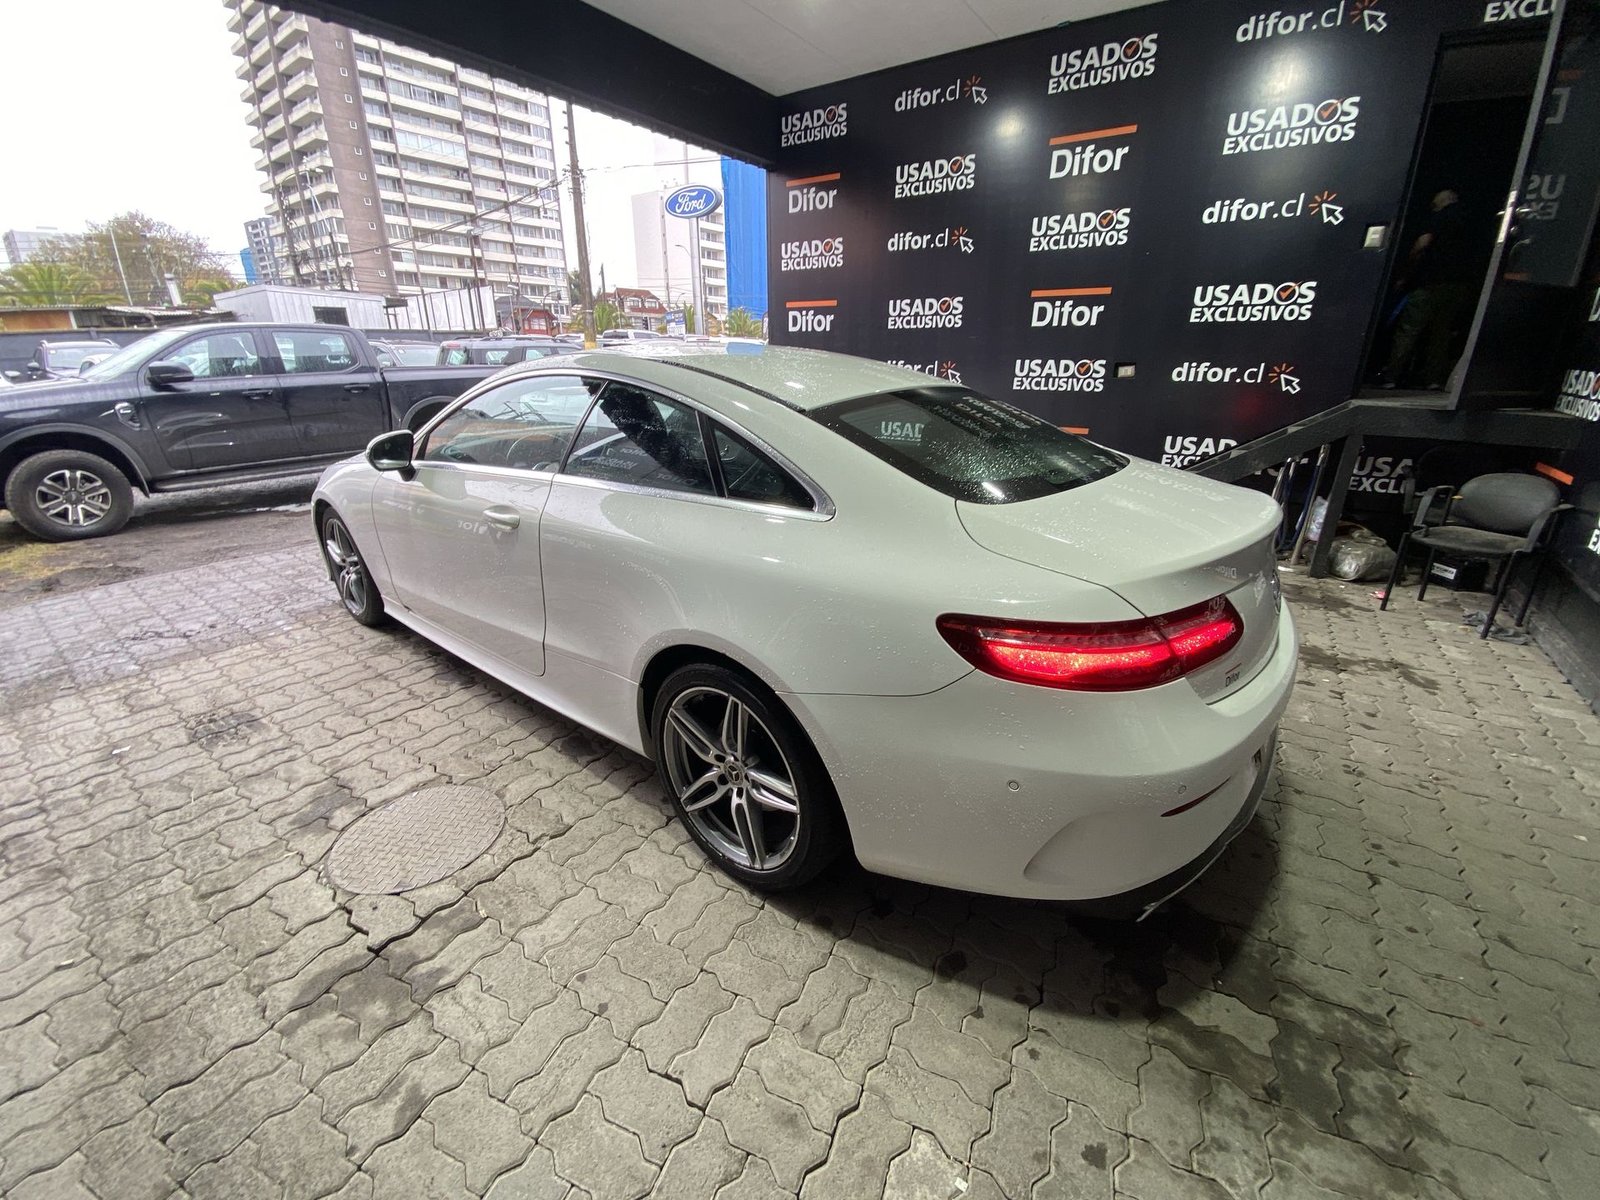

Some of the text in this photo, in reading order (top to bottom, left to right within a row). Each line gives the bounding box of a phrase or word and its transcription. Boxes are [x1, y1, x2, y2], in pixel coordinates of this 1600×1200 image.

[1235, 0, 1346, 43] difor.cl
[1049, 33, 1158, 77] USADOS
[1047, 58, 1156, 95] EXCLUSIVOS
[894, 79, 961, 112] difor.cl
[781, 103, 847, 133] USADOS
[1226, 96, 1361, 136] USADOS
[781, 121, 847, 147] EXCLUSIVOS
[1222, 122, 1356, 155] EXCLUSIVOS
[895, 153, 976, 184] USADOS
[1049, 145, 1130, 180] Difor
[894, 173, 976, 199] EXCLUSIVOS
[675, 191, 706, 214] Ford
[788, 186, 837, 214] Difor
[1202, 192, 1306, 224] difor.cl
[1031, 207, 1131, 236] USADOS
[781, 237, 843, 259] USADOS
[887, 227, 949, 251] difor.cl
[1029, 229, 1129, 252] EXCLUSIVOS
[781, 253, 843, 271] EXCLUSIVOS
[888, 296, 963, 317] USADOS
[1193, 281, 1318, 306] USADOS
[788, 310, 835, 332] Difor
[887, 314, 963, 330] EXCLUSIVOS
[1031, 300, 1105, 327] Difor
[1189, 303, 1313, 323] EXCLUSIVOS
[1014, 359, 1107, 378] USADOS
[1171, 362, 1265, 383] difor.cl
[1012, 376, 1105, 392] EXCLUSIVOS
[1161, 454, 1202, 468] EXC
